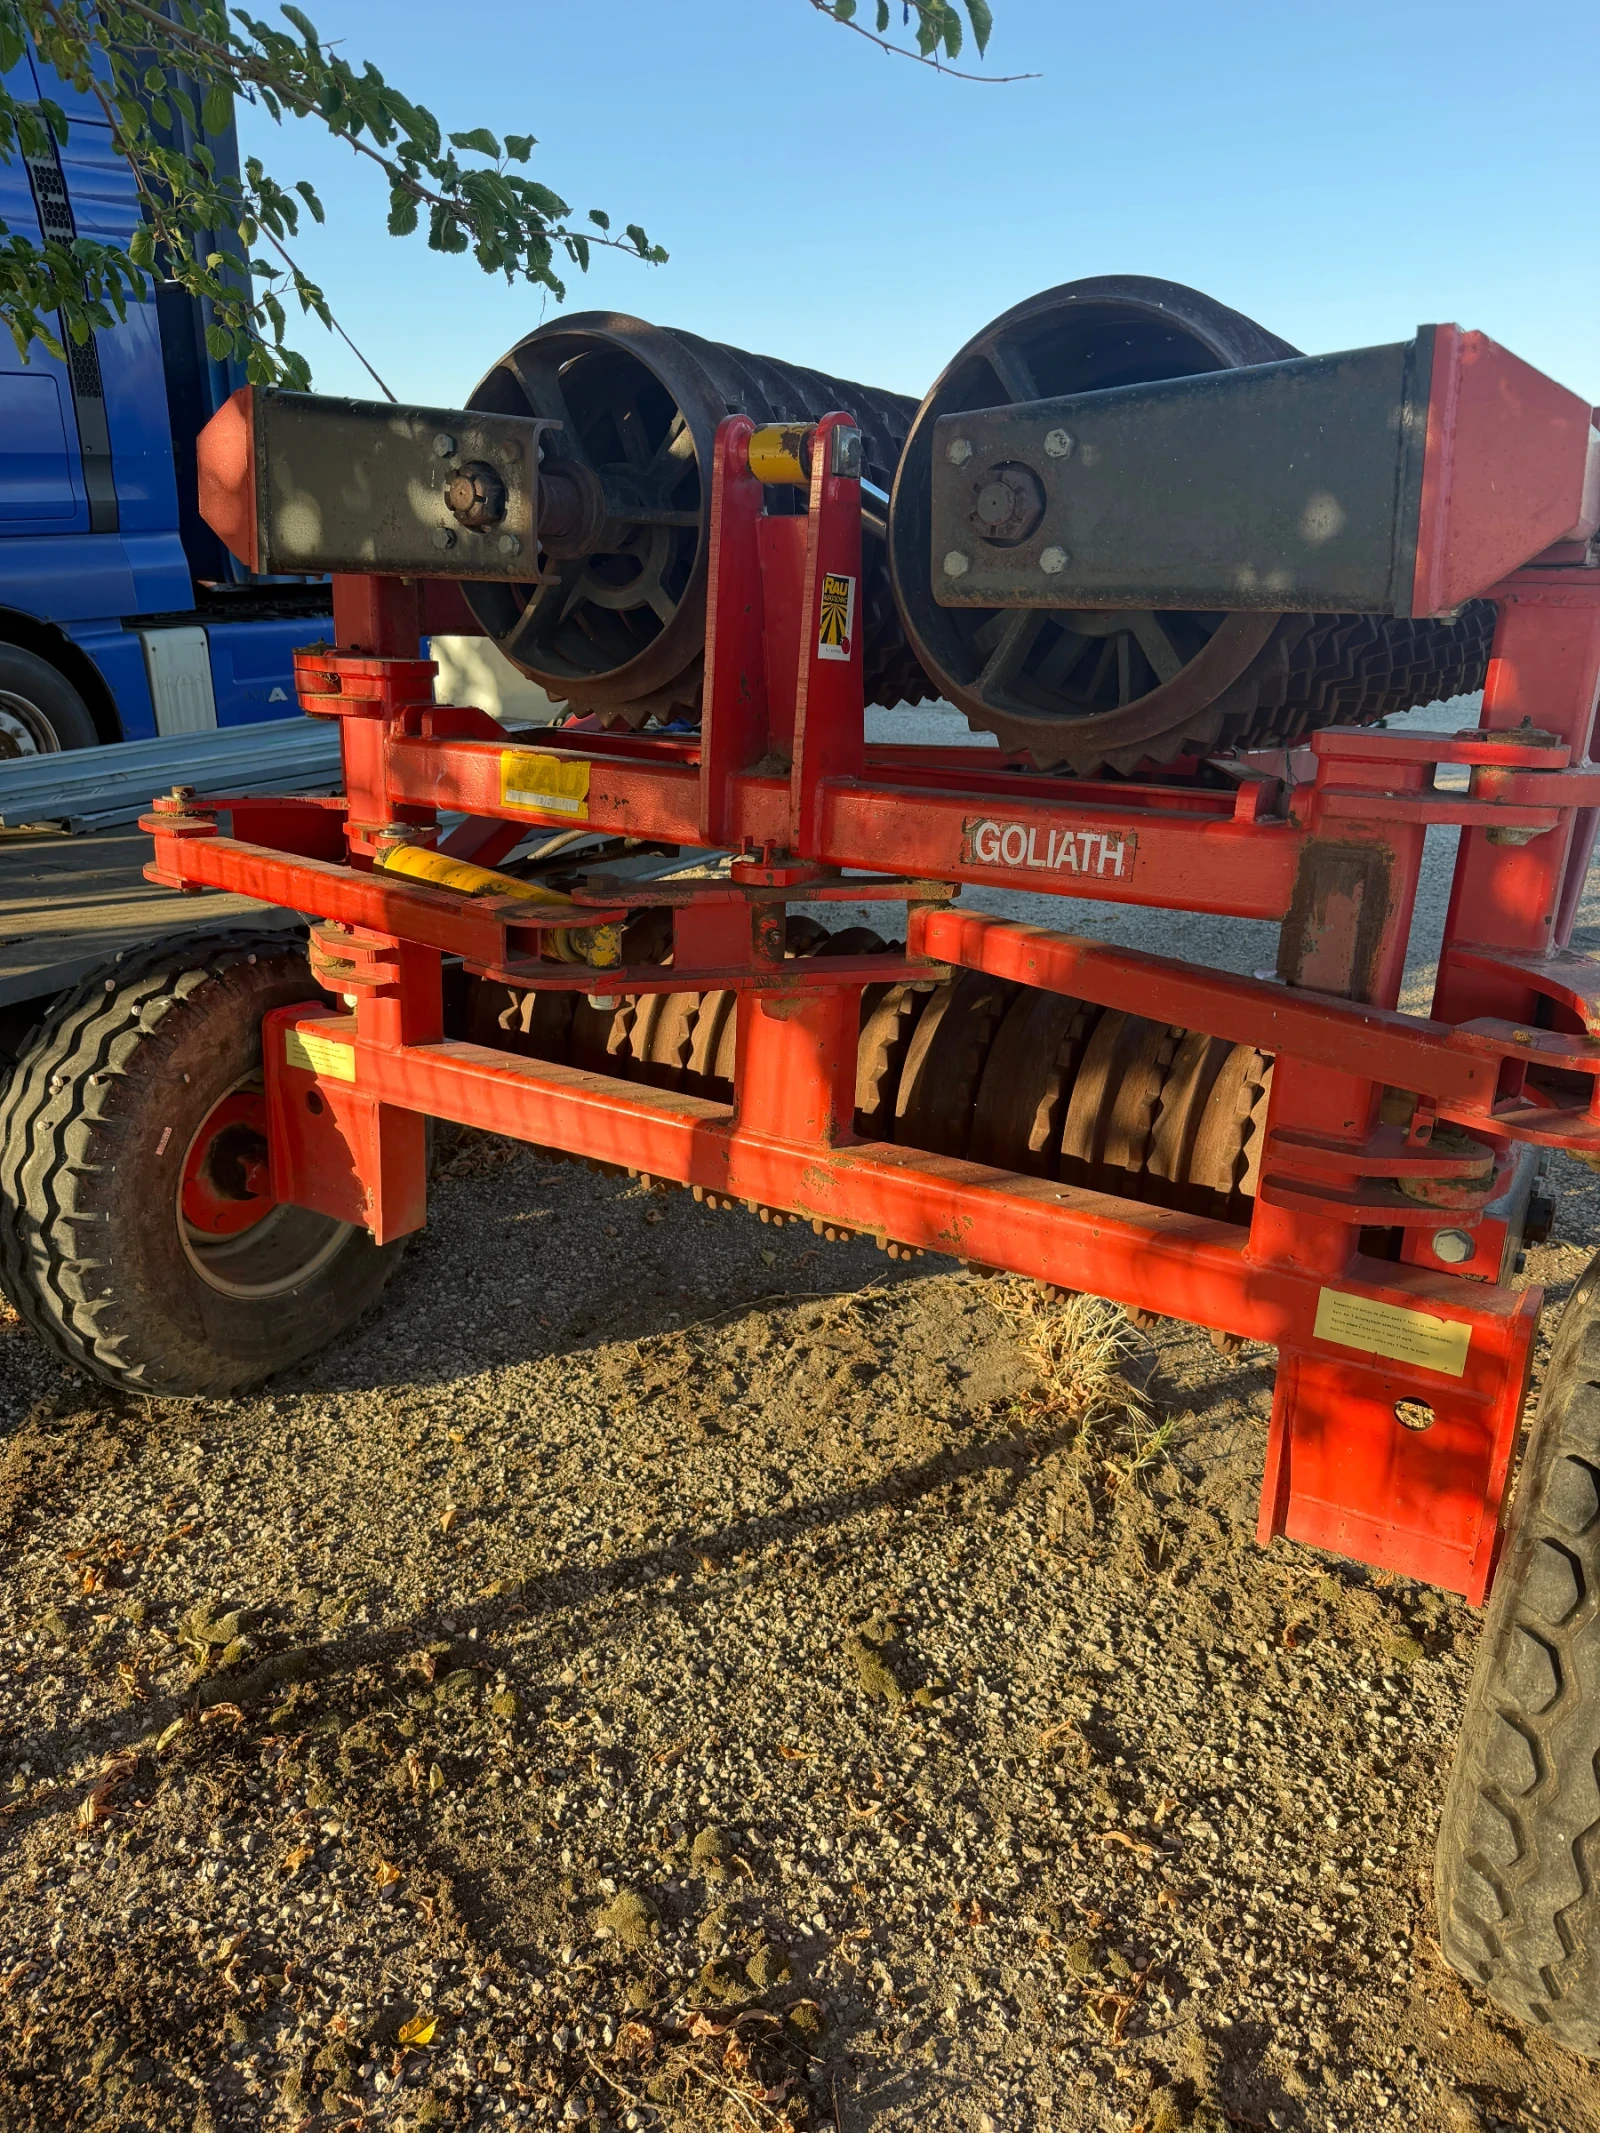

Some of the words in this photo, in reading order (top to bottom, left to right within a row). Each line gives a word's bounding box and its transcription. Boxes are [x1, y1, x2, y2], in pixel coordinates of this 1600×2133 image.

[824, 577, 848, 596] RAU
[506, 757, 586, 797] RAU
[975, 821, 1125, 876] GOLIATH
